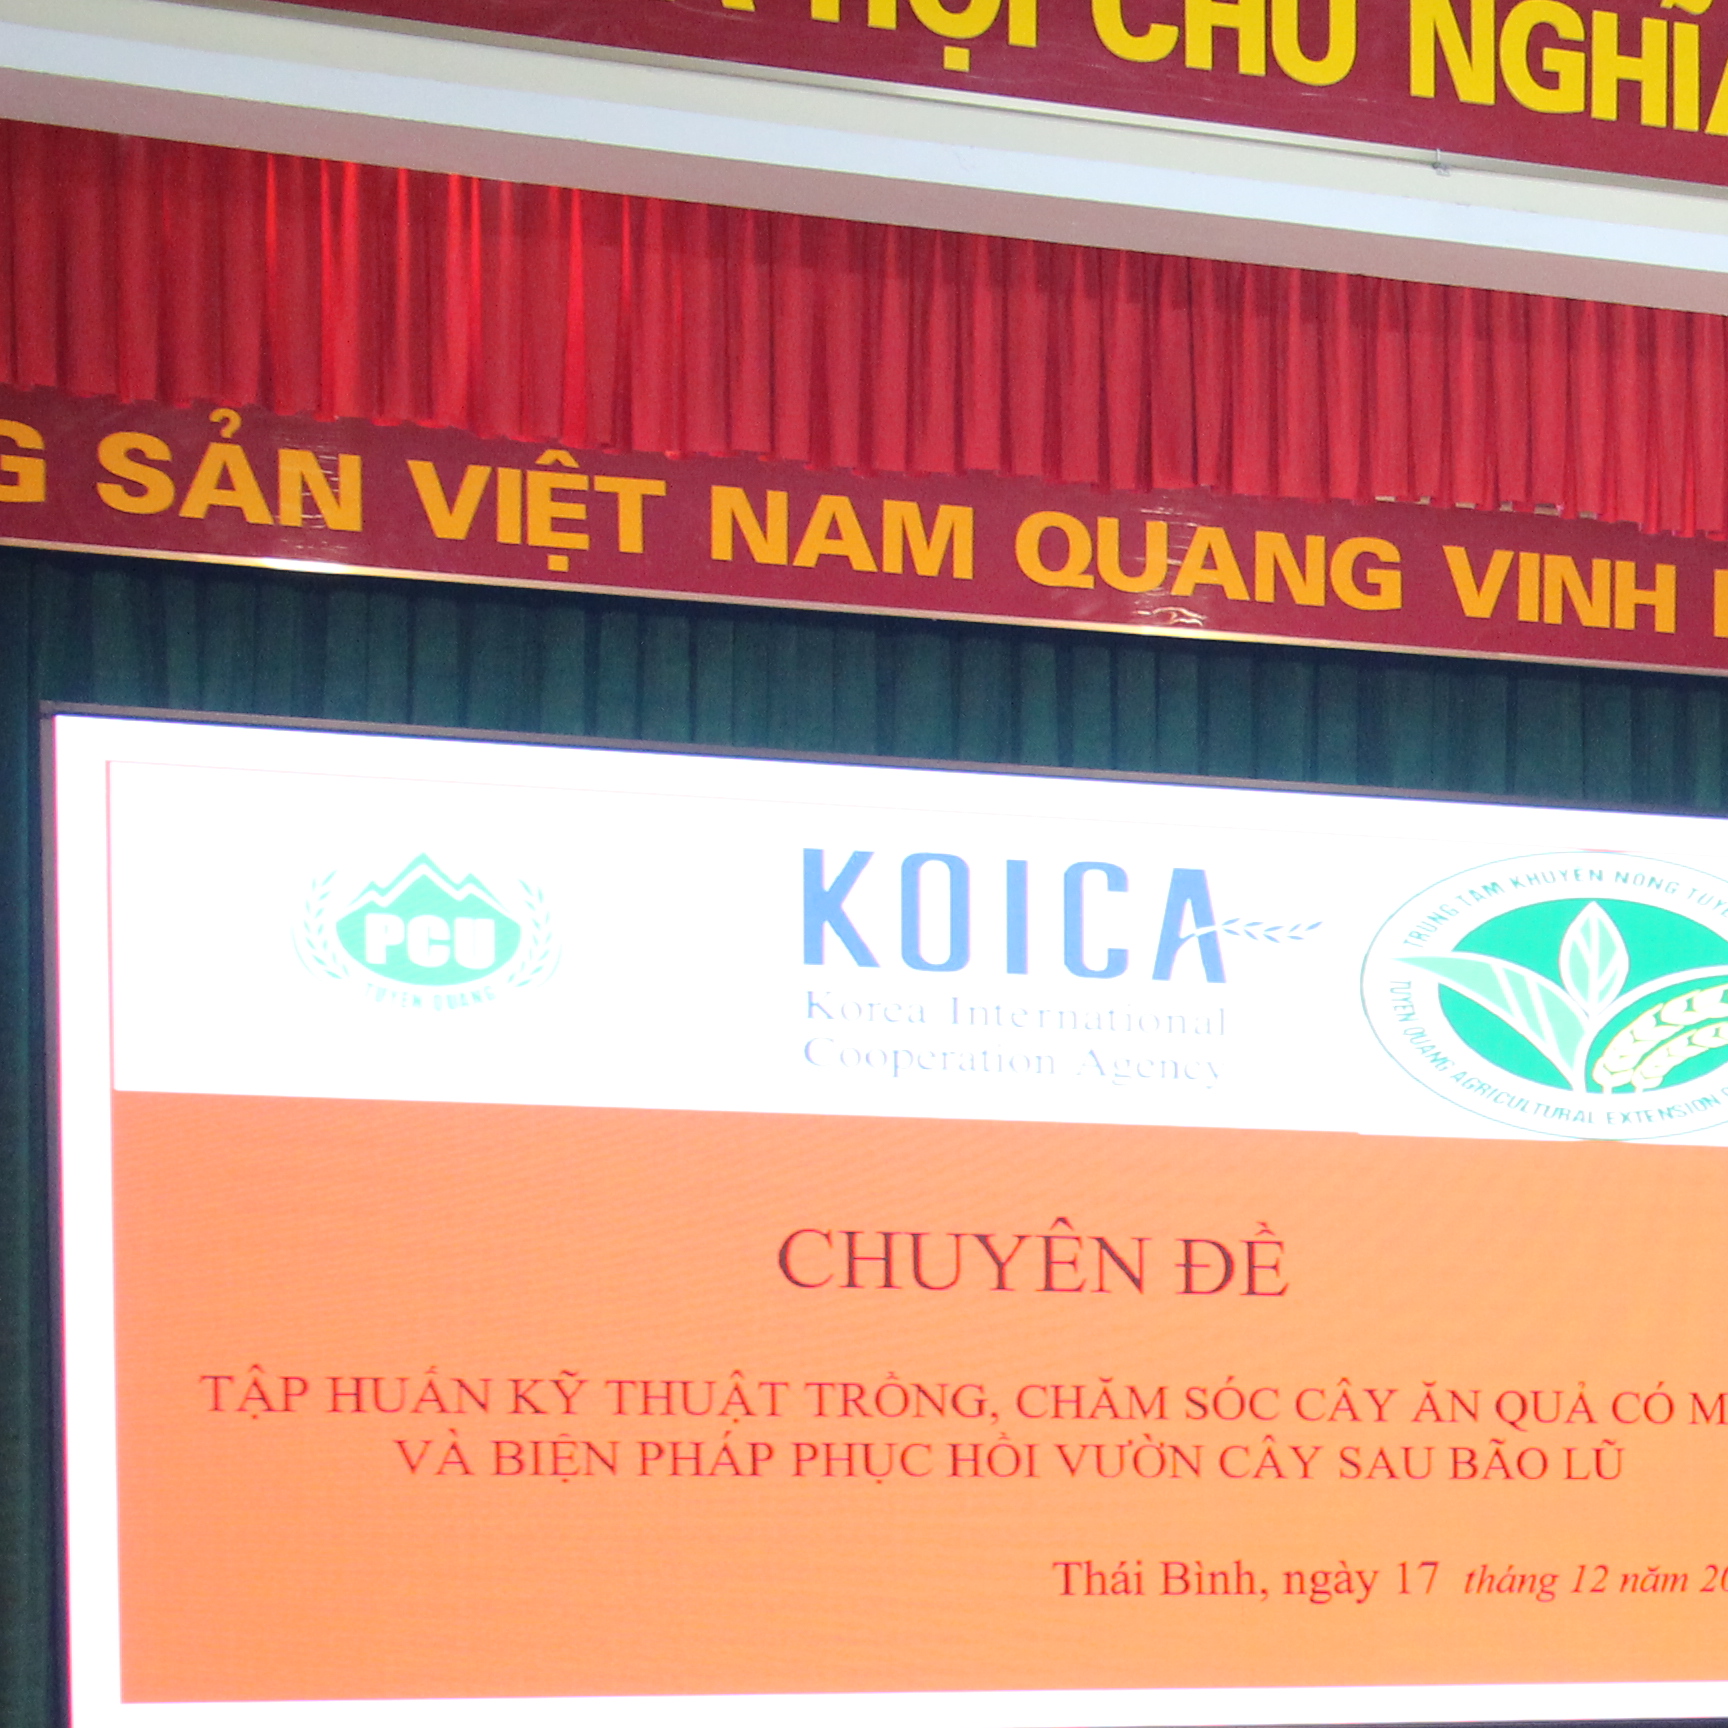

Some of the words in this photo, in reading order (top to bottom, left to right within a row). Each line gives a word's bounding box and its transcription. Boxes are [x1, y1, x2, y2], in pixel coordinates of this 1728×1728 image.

[97, 408, 363, 532] SẢN
[408, 451, 667, 573] VIỆT
[713, 487, 975, 580] NAM
[1017, 513, 1403, 611] QUANG
[1445, 547, 1677, 634] VINH
[365, 913, 495, 969] PCU
[804, 848, 1227, 984] KOICA
[1403, 904, 1459, 947] TRUNG
[808, 992, 926, 1024] Korea
[953, 998, 1225, 1036] International
[805, 1040, 1055, 1078] Cooperation
[1079, 1051, 1219, 1090] Agency
[1450, 1071, 1594, 1124] AGRICULTURAL
[1606, 1094, 1722, 1125] EXTENSION
[779, 1217, 1152, 1294] CHUYÊN
[1176, 1223, 1290, 1297] ĐỀ
[200, 1365, 310, 1420] TẬP
[328, 1367, 493, 1414] HUẤN
[509, 1371, 589, 1415] KỸ
[606, 1371, 791, 1424] THUẬT
[805, 1373, 999, 1422] TRỒNG,
[1017, 1378, 1168, 1421] CHĂM
[1186, 1377, 1280, 1422] SÓC
[1296, 1378, 1399, 1423] CÂY
[1413, 1382, 1481, 1423] ĂN
[1496, 1382, 1598, 1433] QUẢ
[1613, 1381, 1676, 1425] CÓ
[395, 1429, 475, 1476] VÀ
[493, 1435, 619, 1484] BIỆN
[640, 1431, 775, 1477] PHÁP
[794, 1443, 932, 1485] PHỤC
[950, 1434, 1038, 1478] HỒI
[1056, 1434, 1203, 1479] VƯỜN
[1220, 1436, 1323, 1480] CÂY
[1341, 1447, 1435, 1480] SAU
[1451, 1439, 1549, 1481] BÃO
[1566, 1440, 1625, 1481] LŨ
[1053, 1561, 1145, 1597] Thái
[1162, 1561, 1269, 1602] Bình,
[1284, 1560, 1380, 1606] ngày
[1400, 1562, 1440, 1595] 17
[1466, 1565, 1560, 1603] tháng
[1572, 1565, 1610, 1594] 12
[1621, 1567, 1689, 1593] năm
